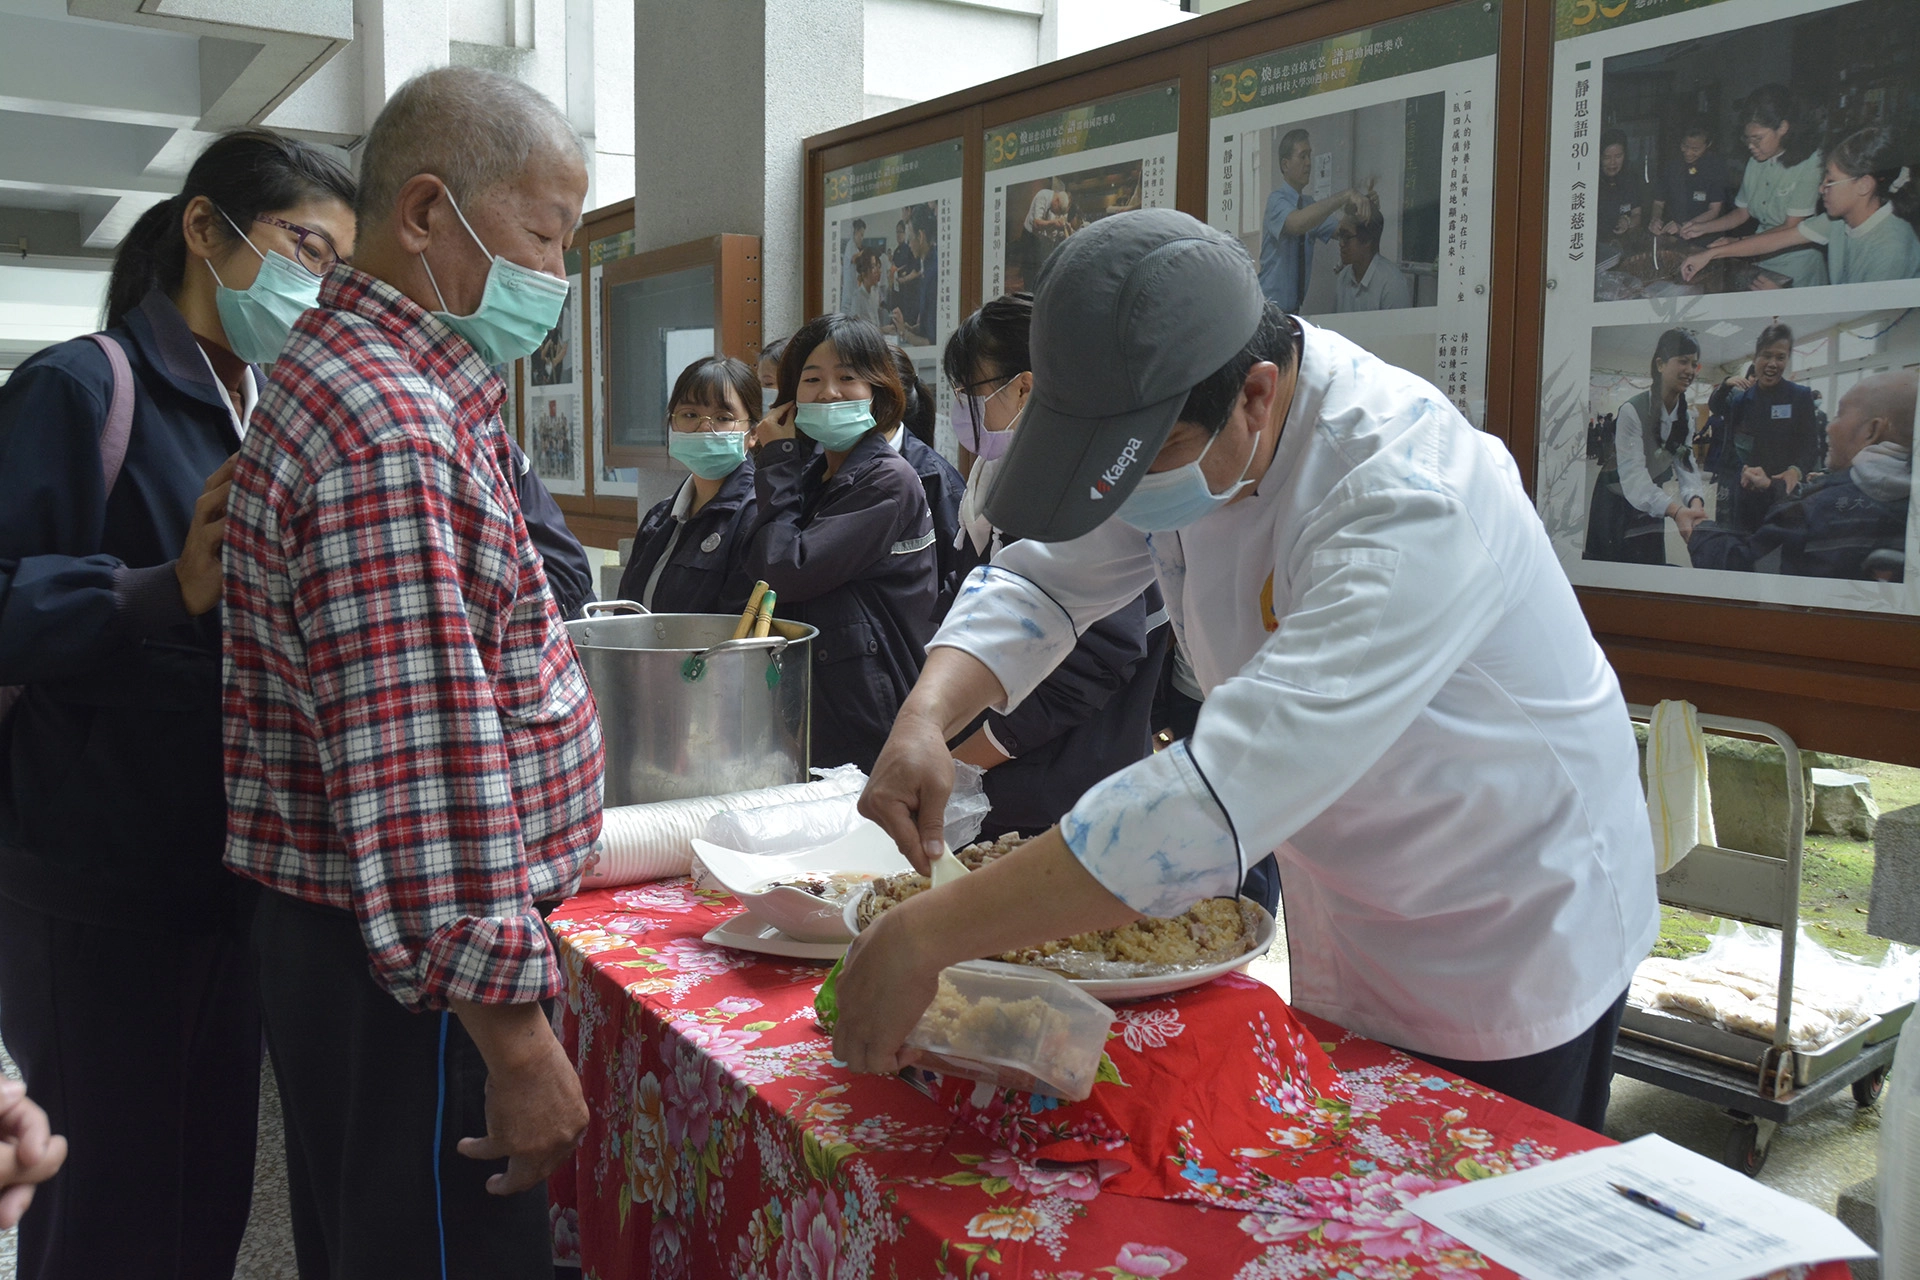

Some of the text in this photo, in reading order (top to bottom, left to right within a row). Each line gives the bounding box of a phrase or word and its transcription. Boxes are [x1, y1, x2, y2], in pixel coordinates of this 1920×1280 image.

[1222, 68, 1258, 107] 30
[993, 132, 1018, 163] 30
[1101, 437, 1143, 486] Kaepa
